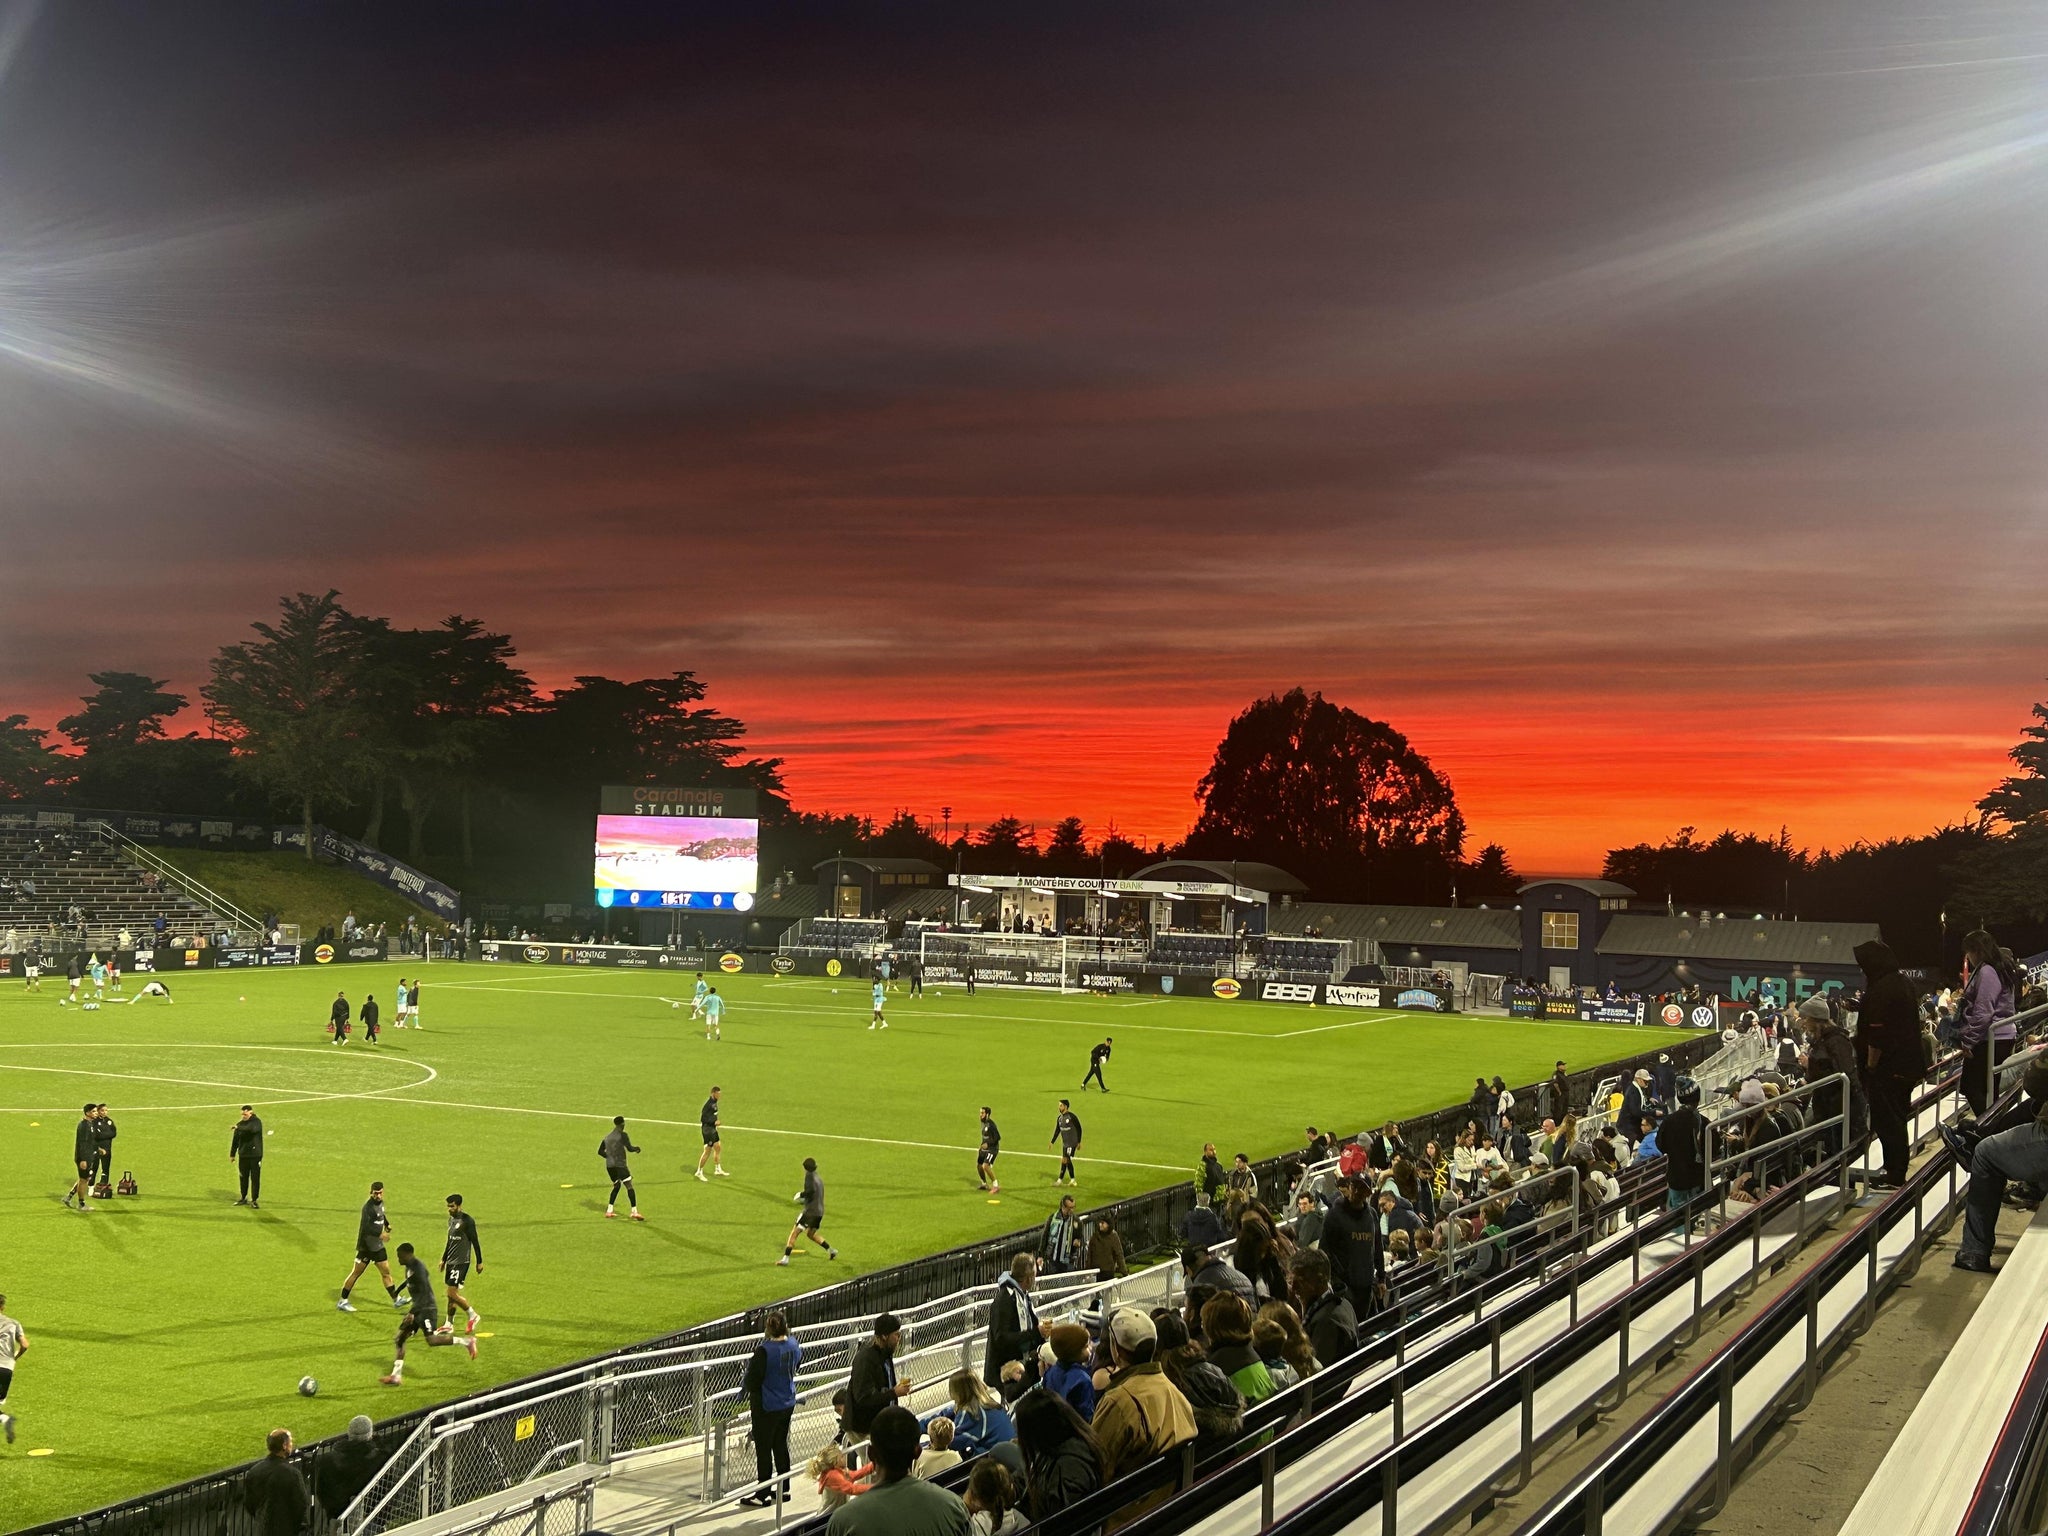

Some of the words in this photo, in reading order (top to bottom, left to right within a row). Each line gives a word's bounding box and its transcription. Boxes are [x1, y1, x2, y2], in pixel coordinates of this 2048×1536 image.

[633, 787, 724, 803] Cardinale
[634, 804, 722, 817] STADIUM
[389, 866, 426, 894] MONTEREY
[1023, 878, 1076, 889] MONTEREY
[1078, 880, 1117, 889] COUNTY
[1119, 881, 1144, 890] BANK
[979, 968, 1012, 976] MONTEREY
[1033, 971, 1069, 979] MONTERY
[1091, 974, 1127, 983] MONTEREY
[1262, 983, 1317, 1002] BBSI
